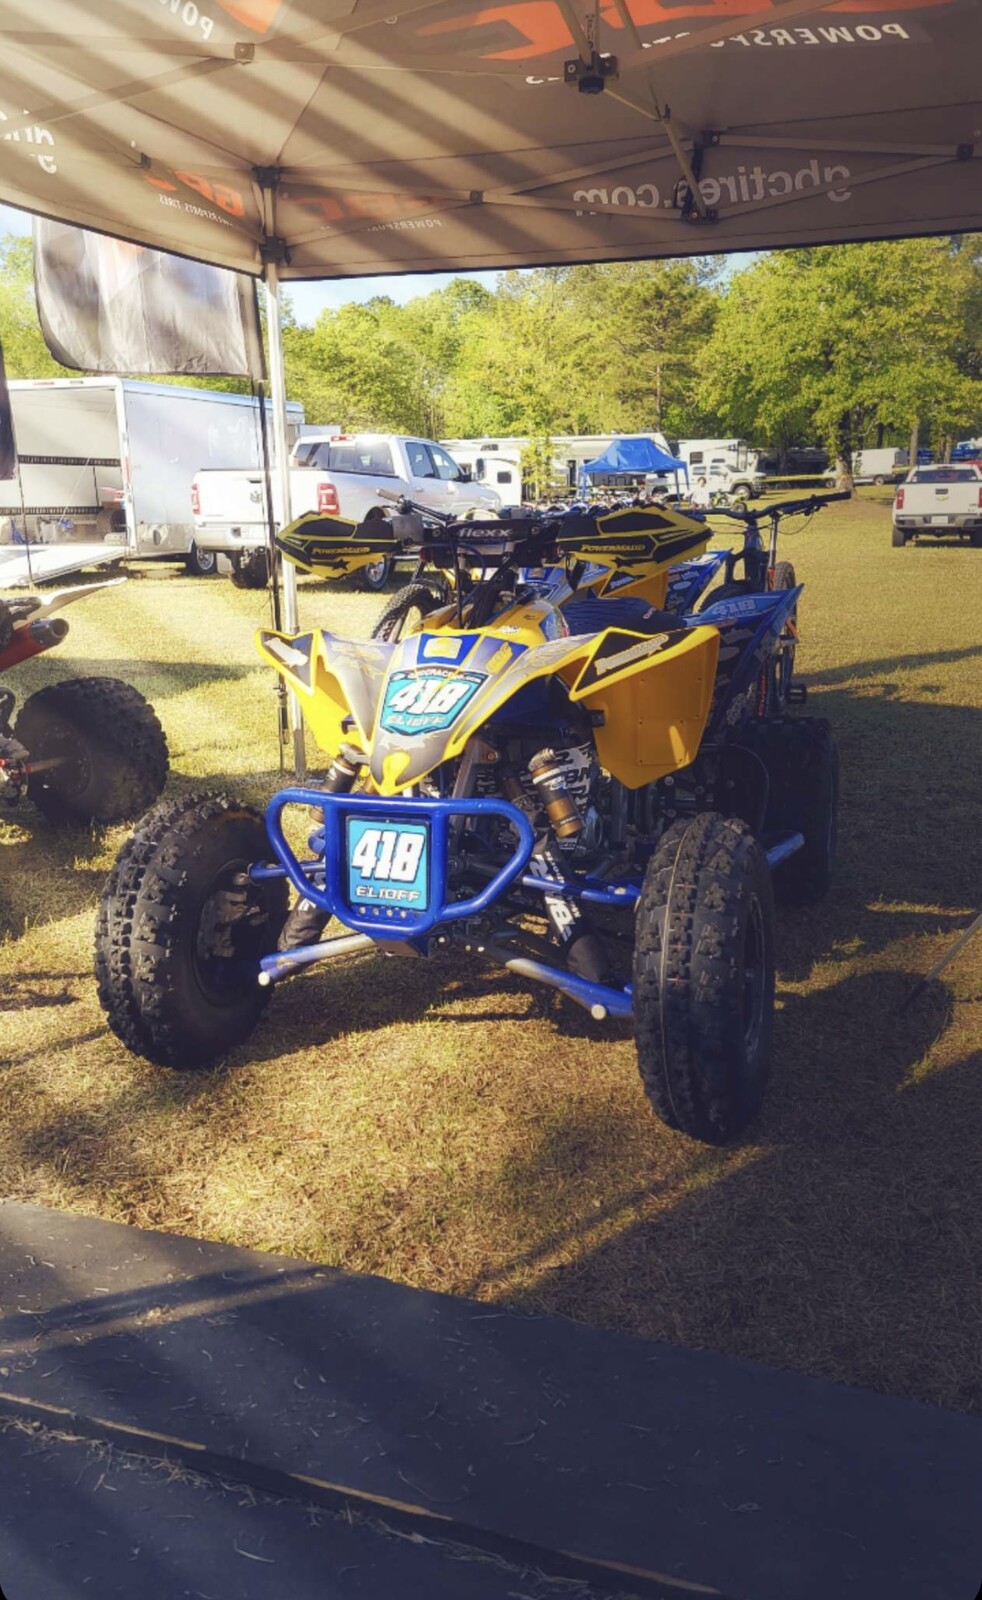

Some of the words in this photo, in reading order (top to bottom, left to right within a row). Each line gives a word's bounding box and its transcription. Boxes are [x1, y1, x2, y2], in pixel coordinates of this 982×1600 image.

[458, 527, 513, 538] flexx
[387, 679, 471, 715] 418
[351, 828, 425, 883] 418
[356, 885, 421, 902] ELIOFF
